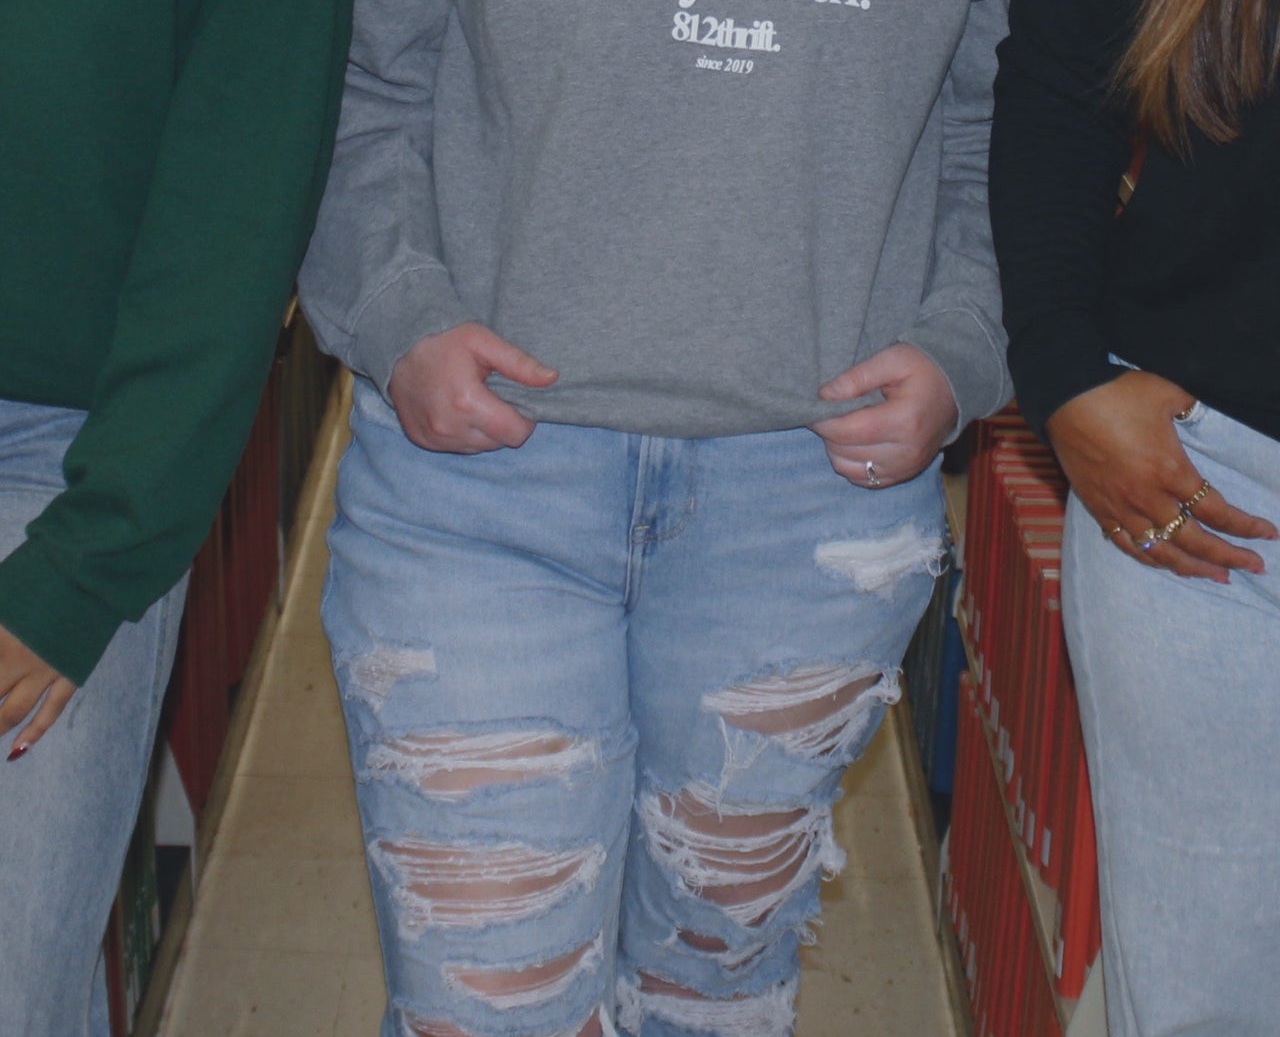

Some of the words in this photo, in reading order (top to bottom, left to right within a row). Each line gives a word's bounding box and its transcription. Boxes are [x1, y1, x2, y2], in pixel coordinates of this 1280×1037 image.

[671, 10, 781, 53] 812thrift.
[695, 53, 723, 72] since
[724, 57, 754, 75] 2019
